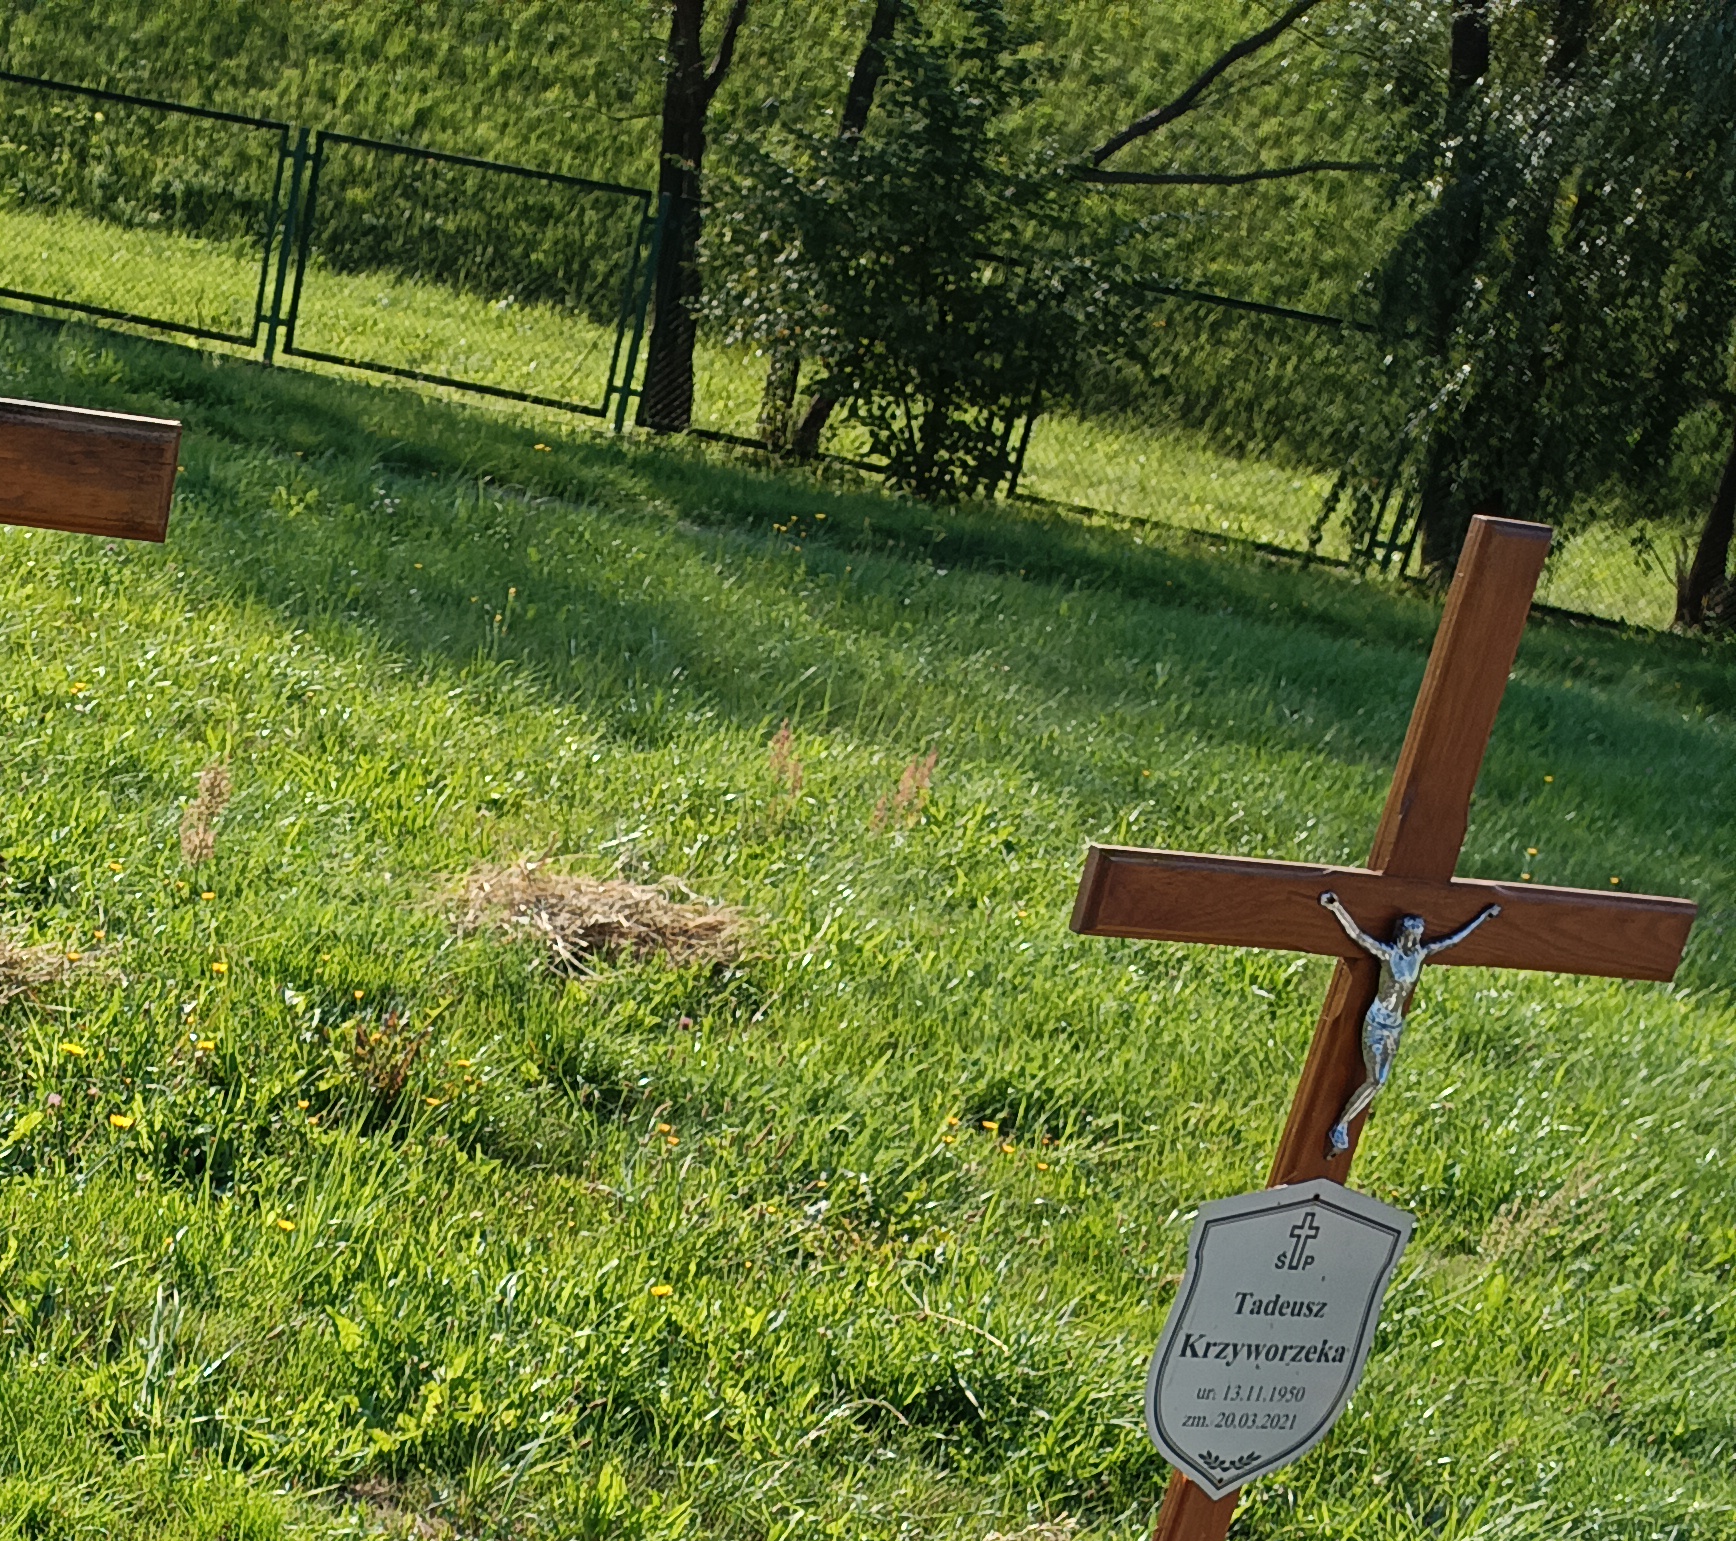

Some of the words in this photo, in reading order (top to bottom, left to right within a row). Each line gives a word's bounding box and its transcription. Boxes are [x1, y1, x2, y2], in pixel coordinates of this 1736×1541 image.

[1302, 1255, 1315, 1270] P
[1234, 1292, 1328, 1319] Tadeusz
[1178, 1333, 1346, 1367] Krzyworzeka
[1197, 1386, 1217, 1401] ur.
[1222, 1384, 1306, 1403] 13.11.1950
[1182, 1414, 1209, 1428] zm.
[1214, 1411, 1297, 1431] 20.03.2021
